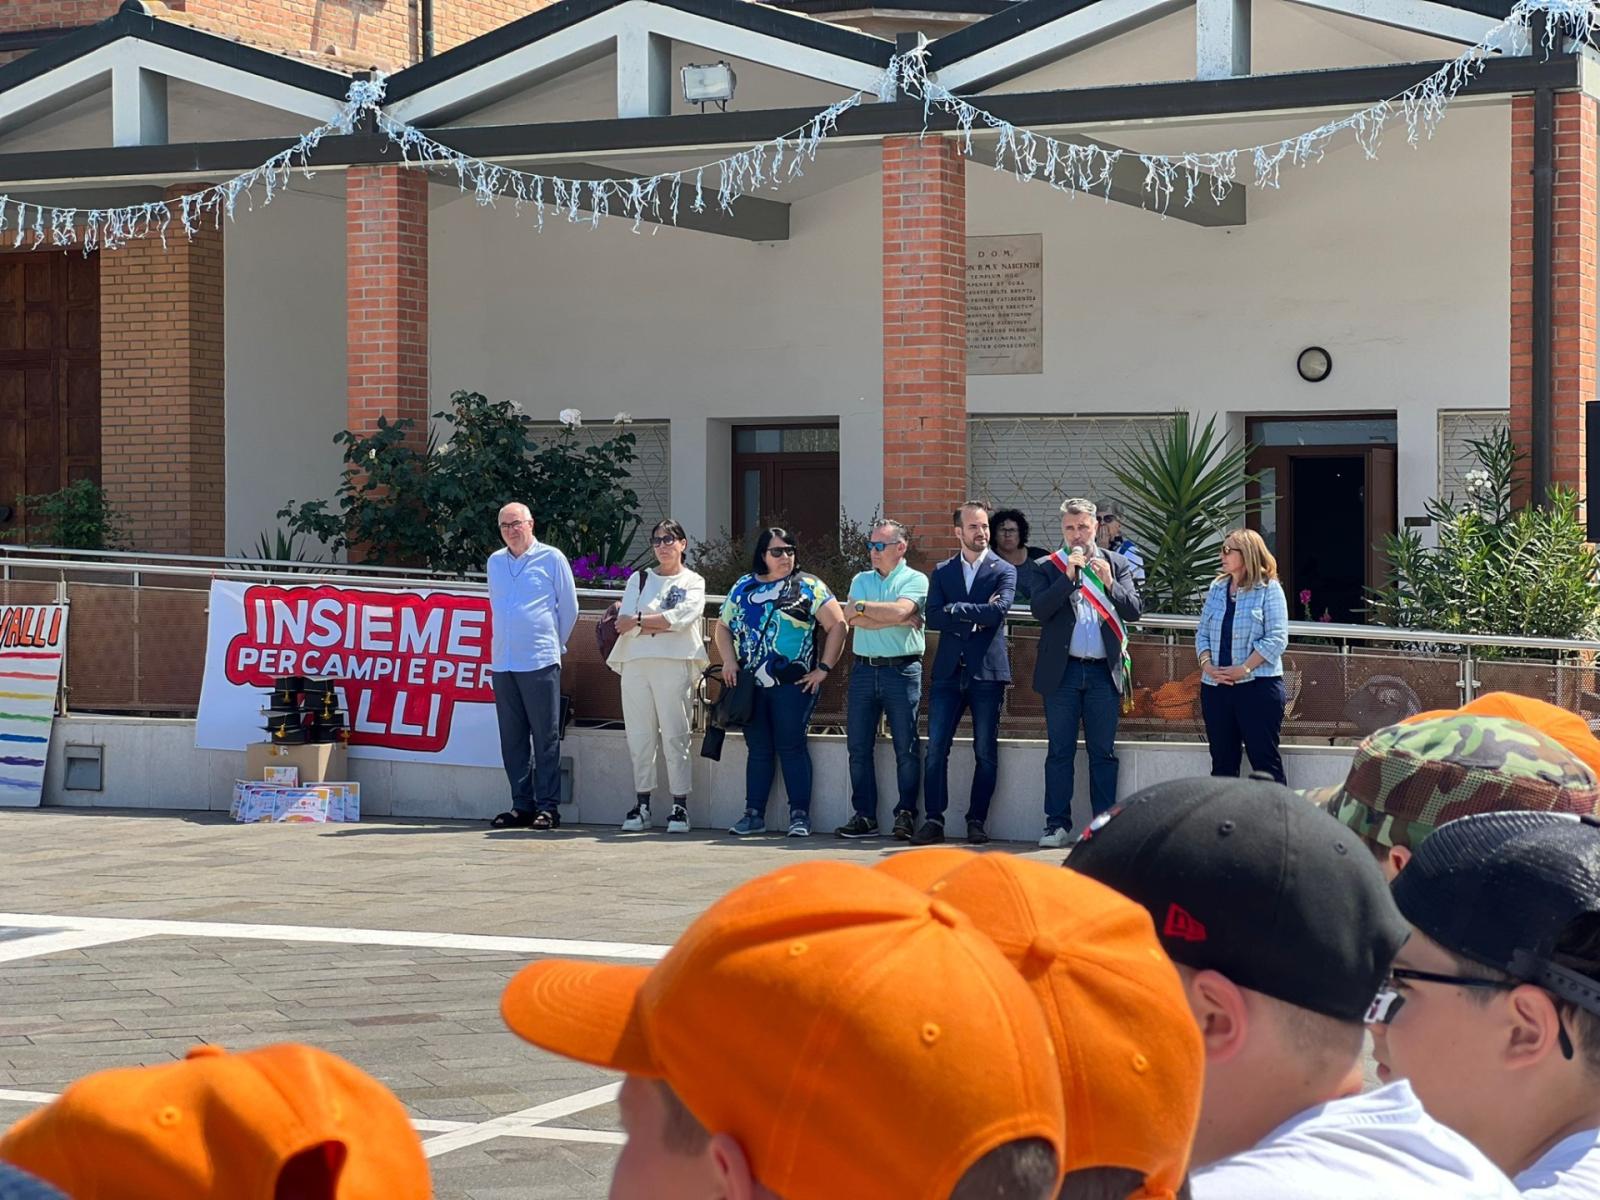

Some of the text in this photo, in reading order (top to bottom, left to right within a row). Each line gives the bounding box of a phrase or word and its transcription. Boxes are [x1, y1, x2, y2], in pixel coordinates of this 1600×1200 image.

[254, 598, 486, 658] INSIEME
[237, 647, 493, 690] PER CAMPI E PER
